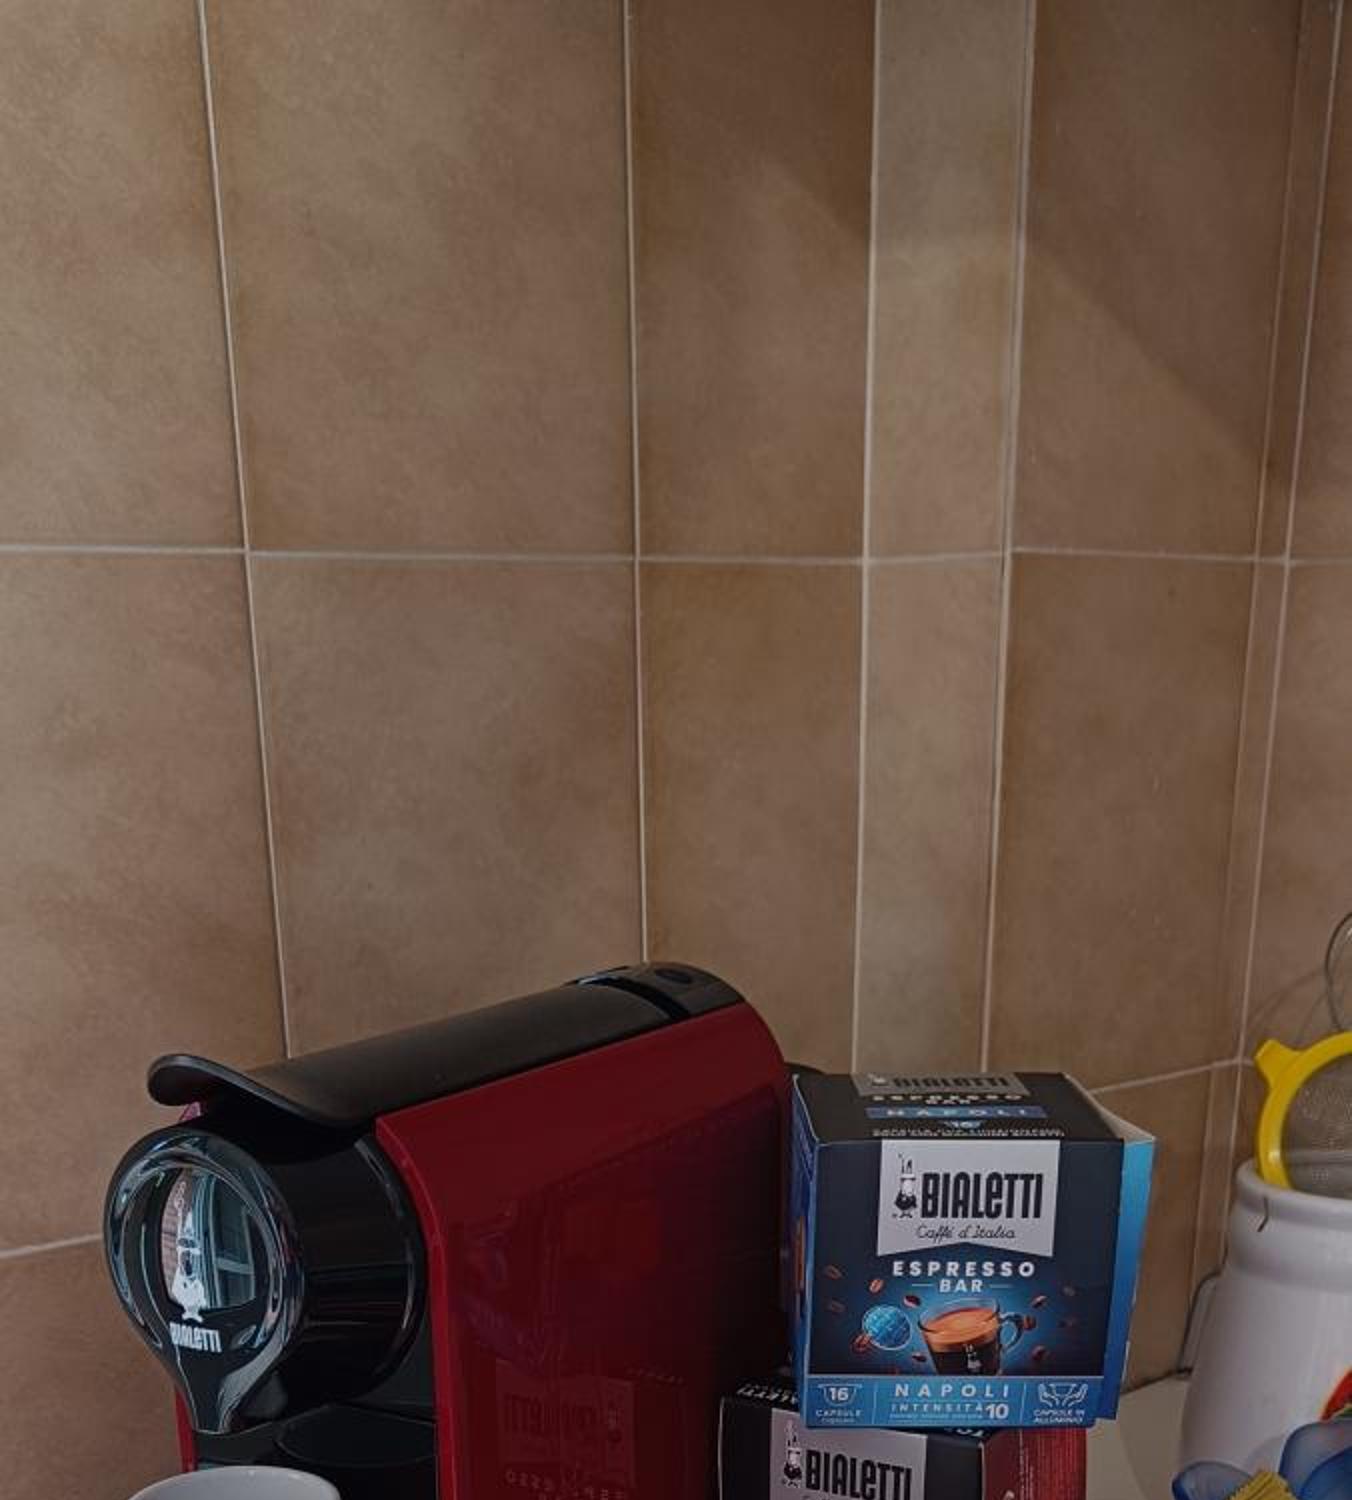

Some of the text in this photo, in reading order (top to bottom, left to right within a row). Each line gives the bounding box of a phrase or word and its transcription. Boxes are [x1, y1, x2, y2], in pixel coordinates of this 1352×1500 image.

[892, 1260, 1036, 1277] ESPRESSO
[939, 1278, 984, 1293] BAR
[828, 1386, 849, 1401] 16
[895, 1383, 1010, 1398] NAPOLI
[815, 1409, 862, 1417] CAPSULE
[985, 1403, 1009, 1419] 10
